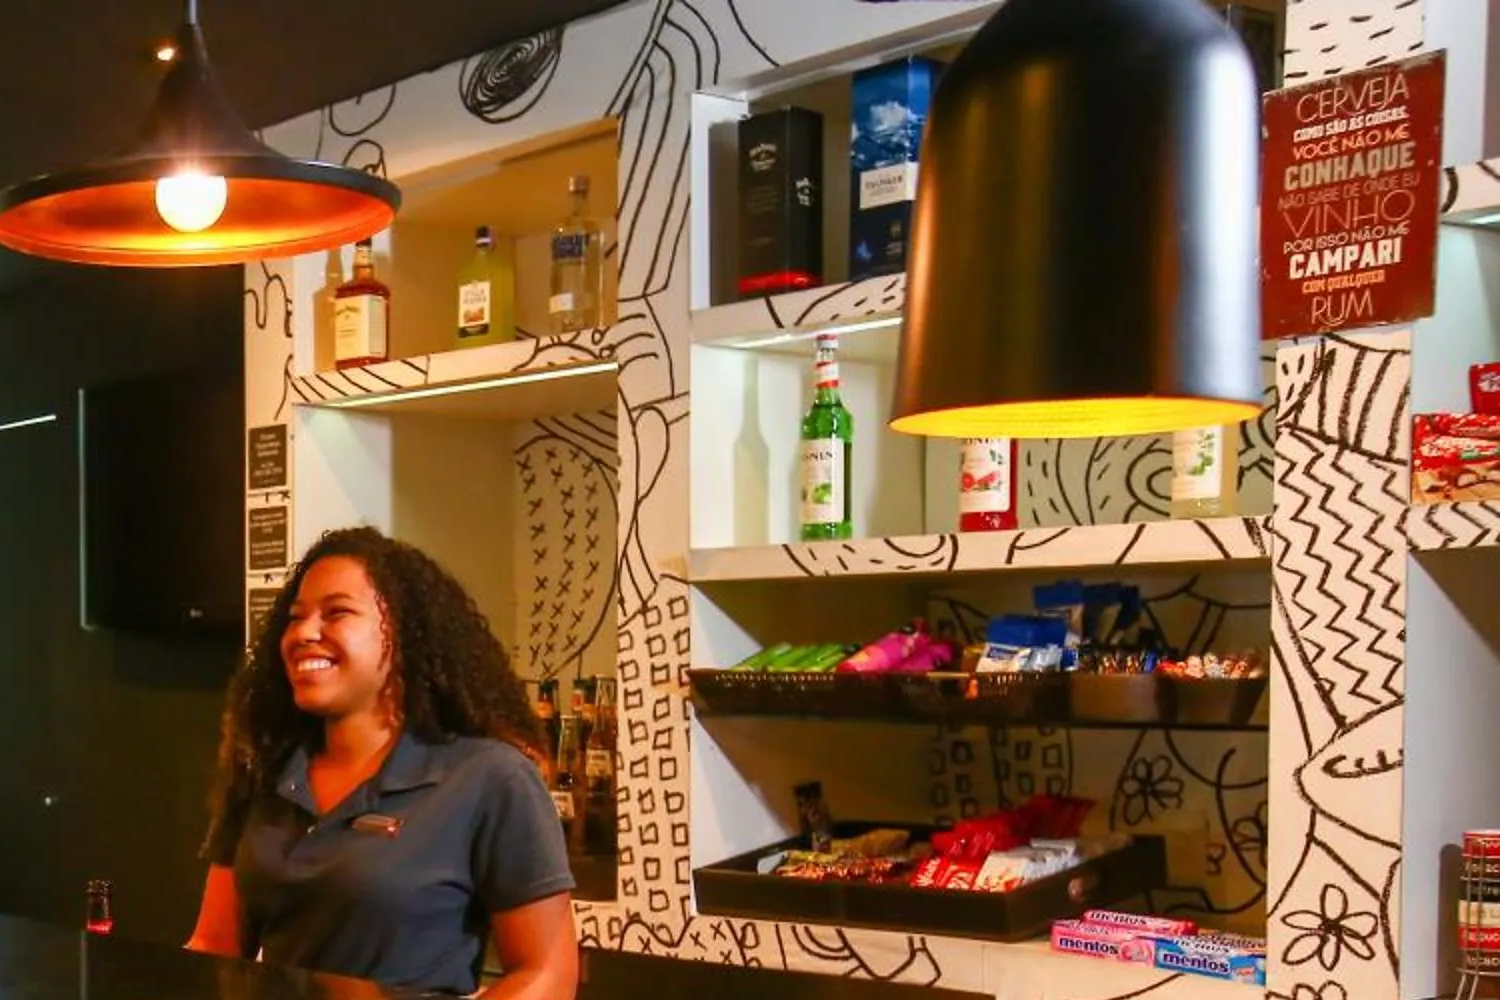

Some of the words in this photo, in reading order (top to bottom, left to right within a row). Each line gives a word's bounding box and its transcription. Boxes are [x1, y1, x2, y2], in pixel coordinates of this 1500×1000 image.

[1296, 73, 1409, 123] CERVEJA
[1293, 135, 1339, 160] VOCÊ
[1341, 129, 1381, 152] NÃO
[1384, 121, 1411, 142] ME
[1284, 141, 1417, 191] CONHAQUE
[1342, 180, 1361, 200] DE
[1283, 188, 1416, 238] VINHO
[1283, 238, 1313, 255] POR
[1315, 231, 1349, 250] ISSO
[1351, 225, 1385, 243] NÃO
[1387, 219, 1411, 236] ME
[1289, 236, 1402, 280] CAMPARI
[1311, 288, 1374, 327] RUM
[1059, 936, 1119, 955] mentos
[1163, 953, 1229, 973] mentos
